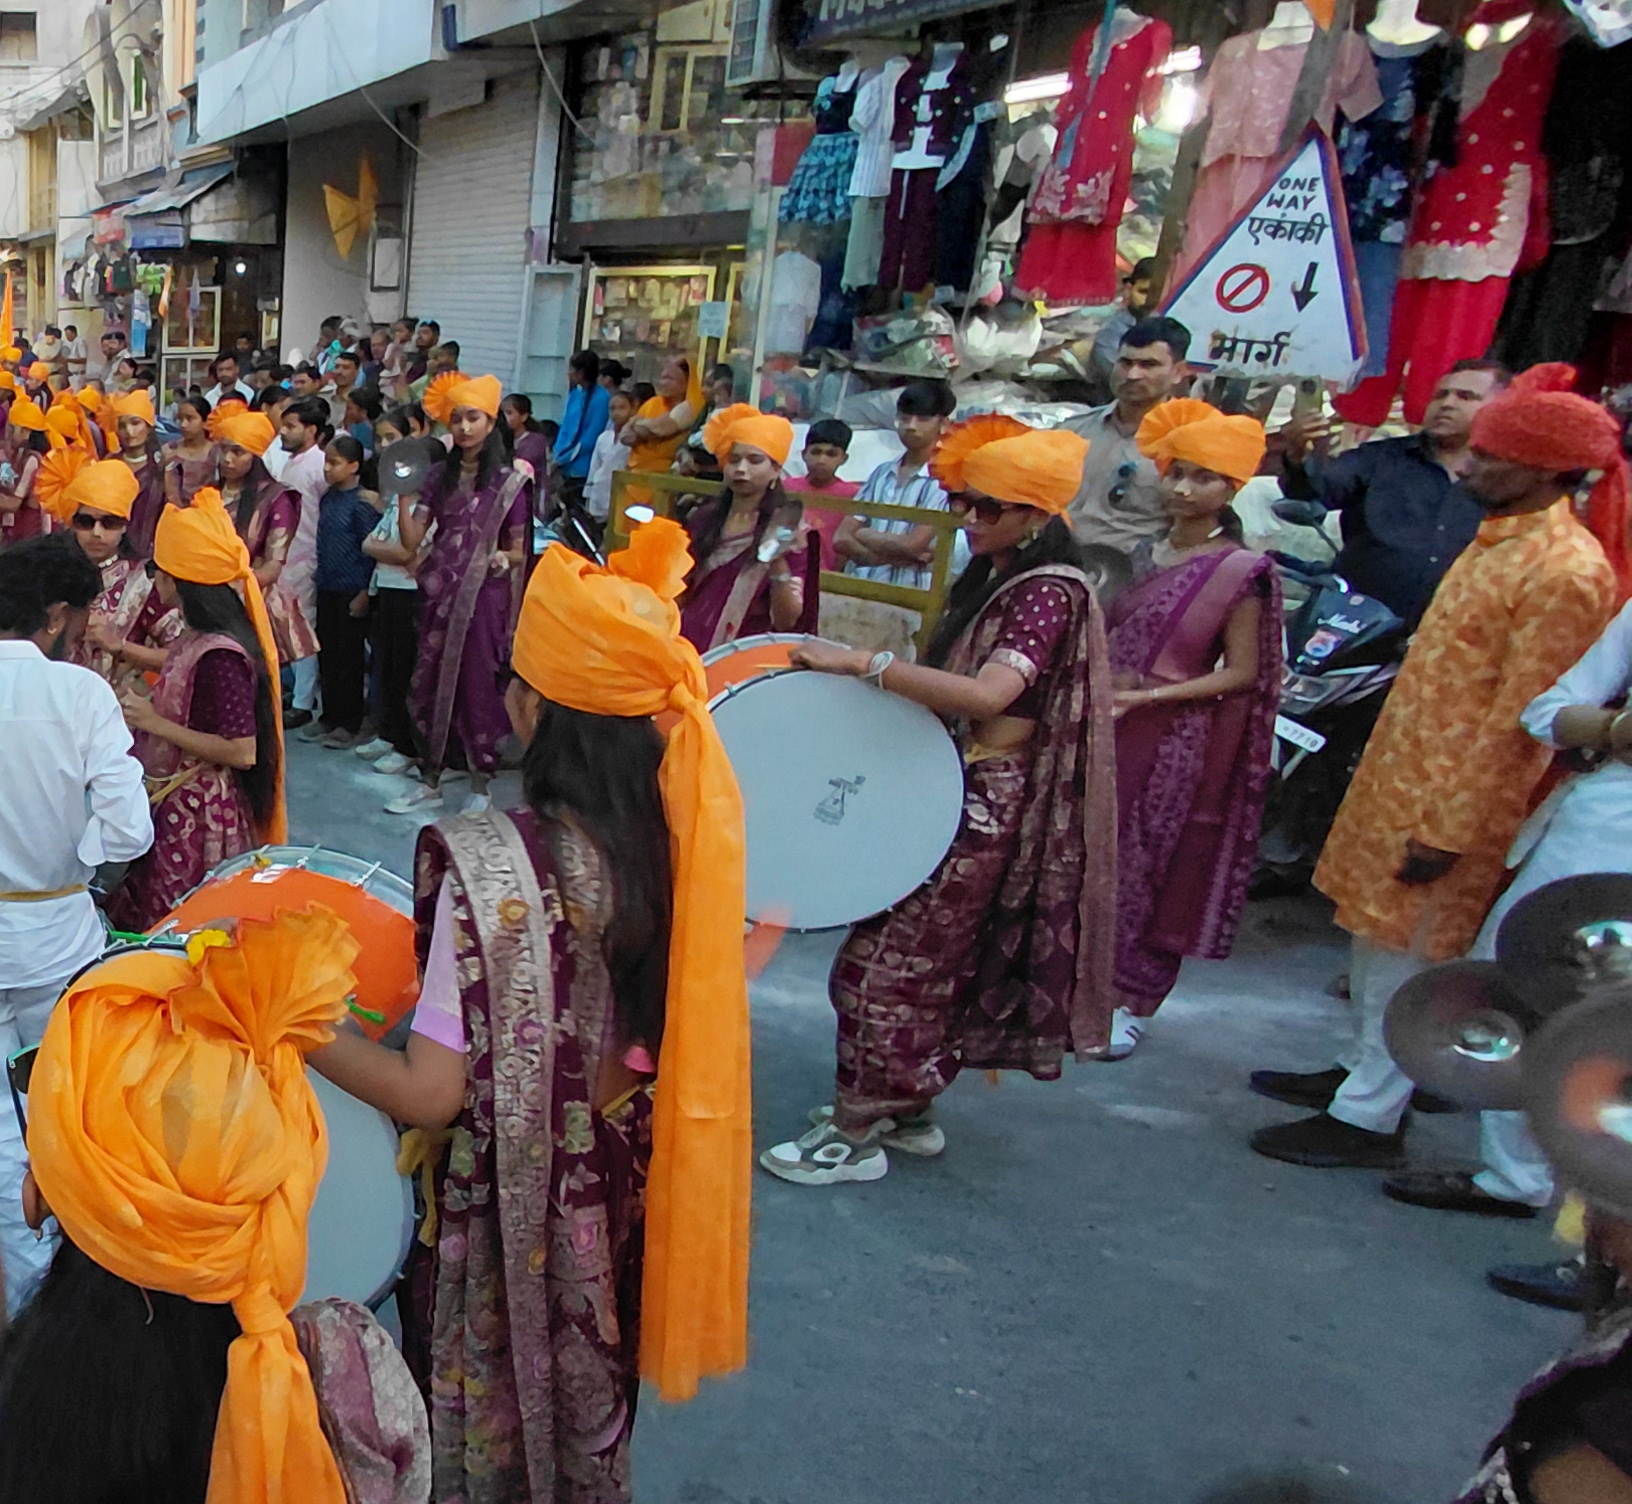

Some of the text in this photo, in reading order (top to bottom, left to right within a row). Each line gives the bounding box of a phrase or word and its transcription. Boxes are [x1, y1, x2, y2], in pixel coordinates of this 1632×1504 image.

[1278, 177, 1320, 192] ONE
[1266, 193, 1317, 211] WAY
[1208, 330, 1293, 367] मार्ग
